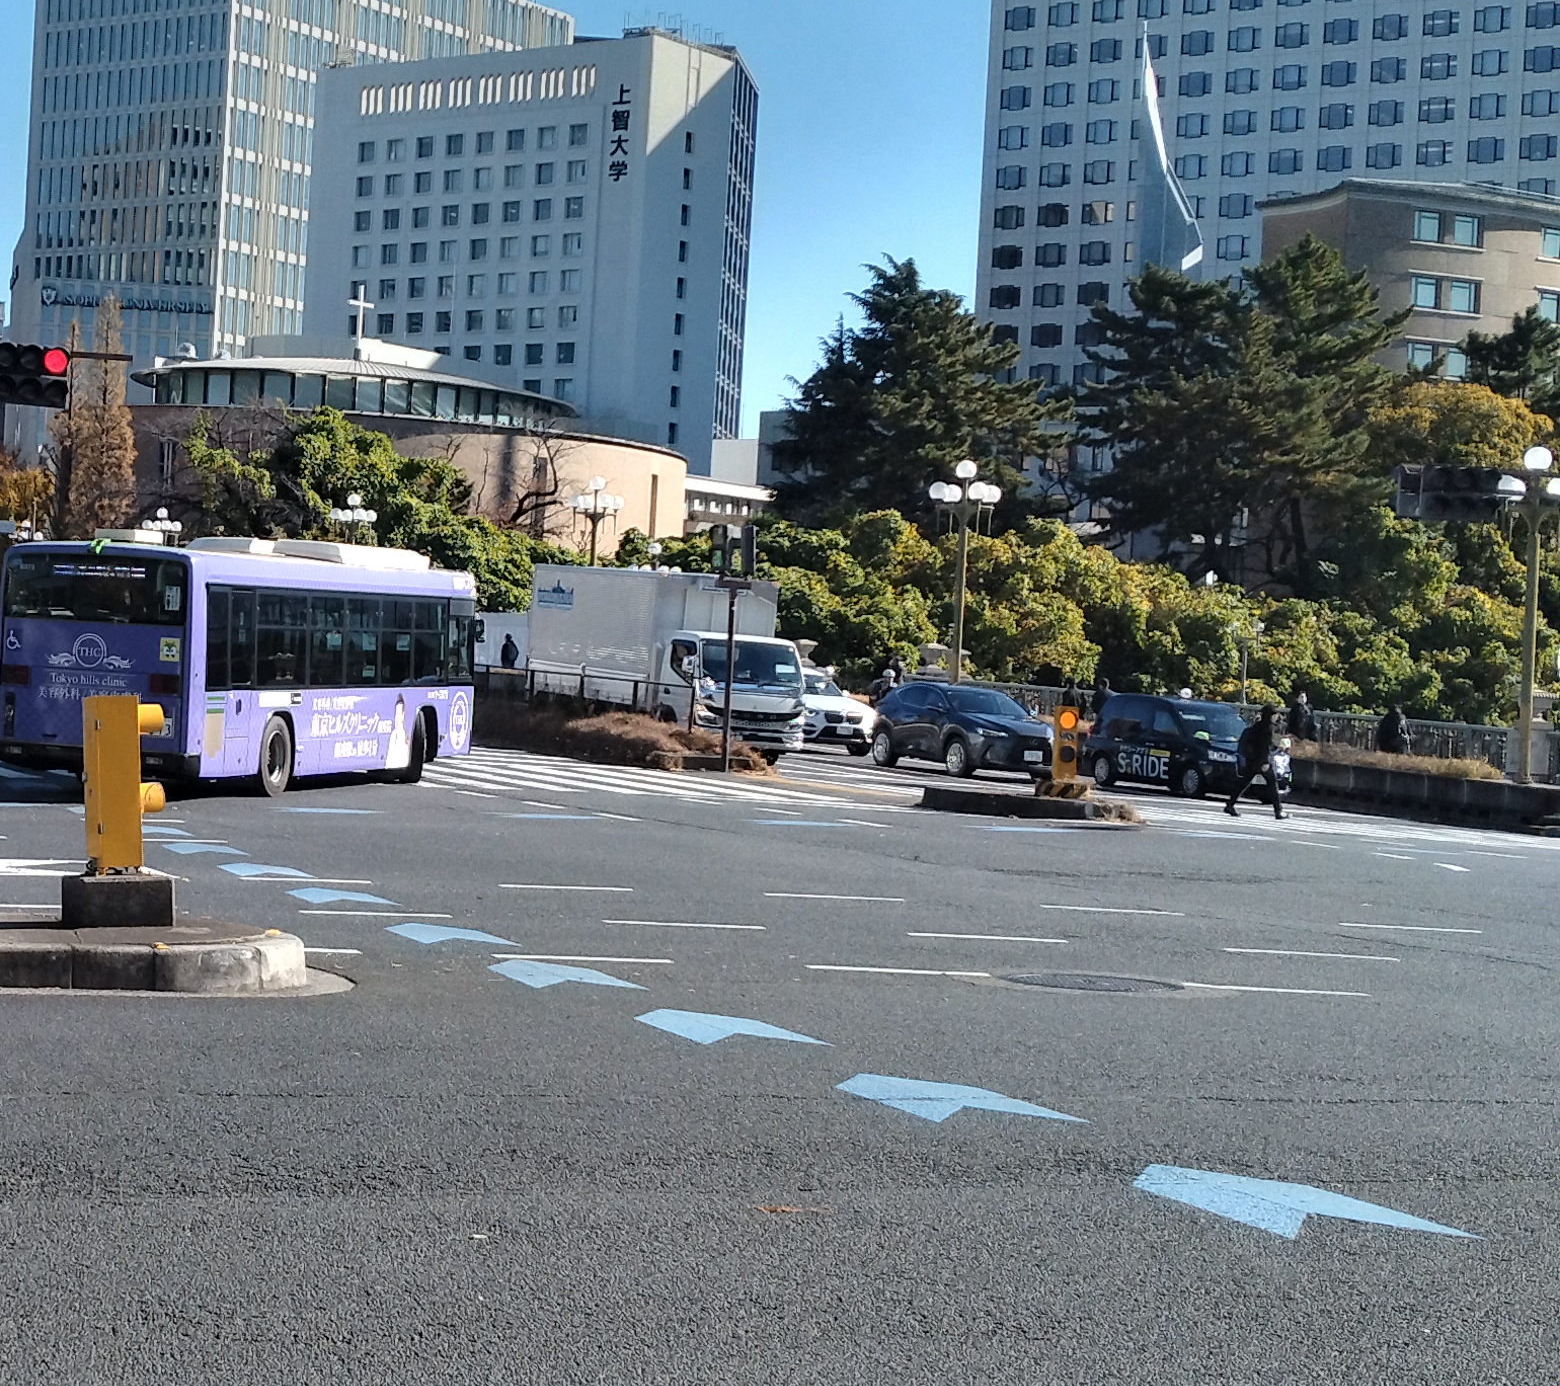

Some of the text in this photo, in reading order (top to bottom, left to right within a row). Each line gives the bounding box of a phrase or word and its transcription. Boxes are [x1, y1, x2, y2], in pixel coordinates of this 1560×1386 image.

[609, 83, 631, 182] 上智大学
[78, 646, 102, 658] THC
[50, 672, 128, 688] Tokyo hills clinic
